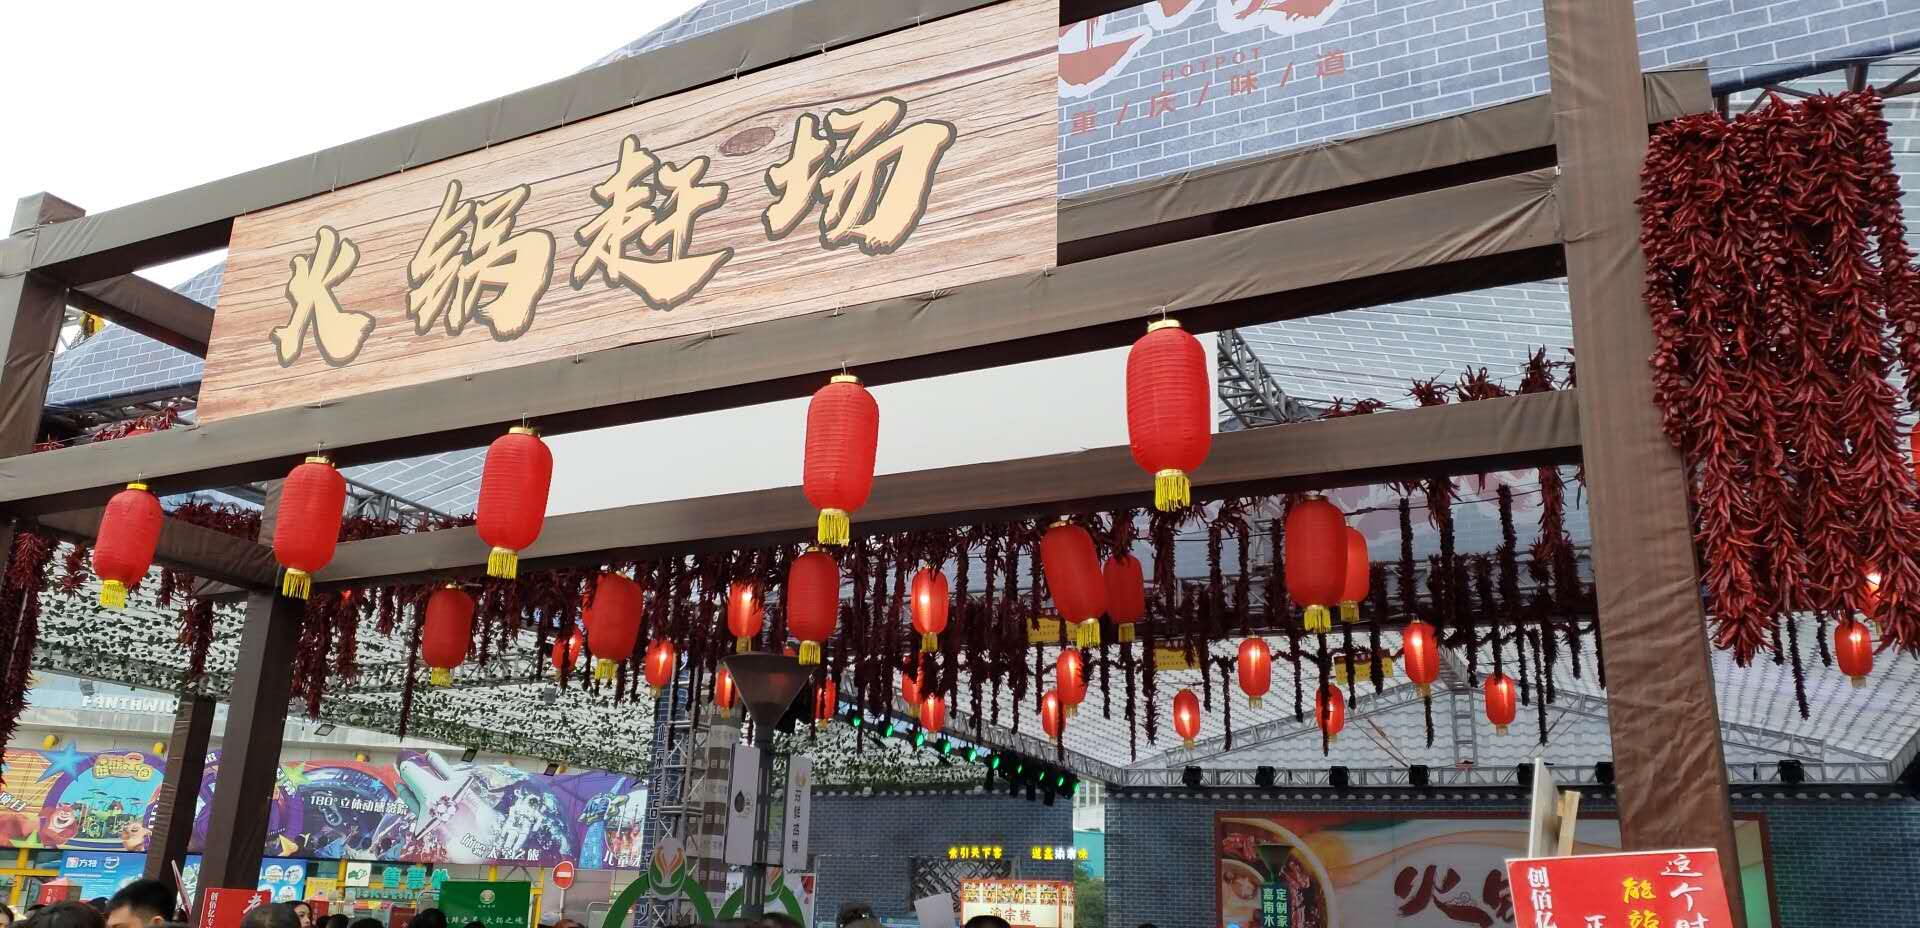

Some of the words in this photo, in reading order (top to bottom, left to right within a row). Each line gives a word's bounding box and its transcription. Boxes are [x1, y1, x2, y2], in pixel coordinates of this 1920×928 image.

[1161, 47, 1261, 83] HOTPOT
[269, 96, 958, 368] 火锅赶场
